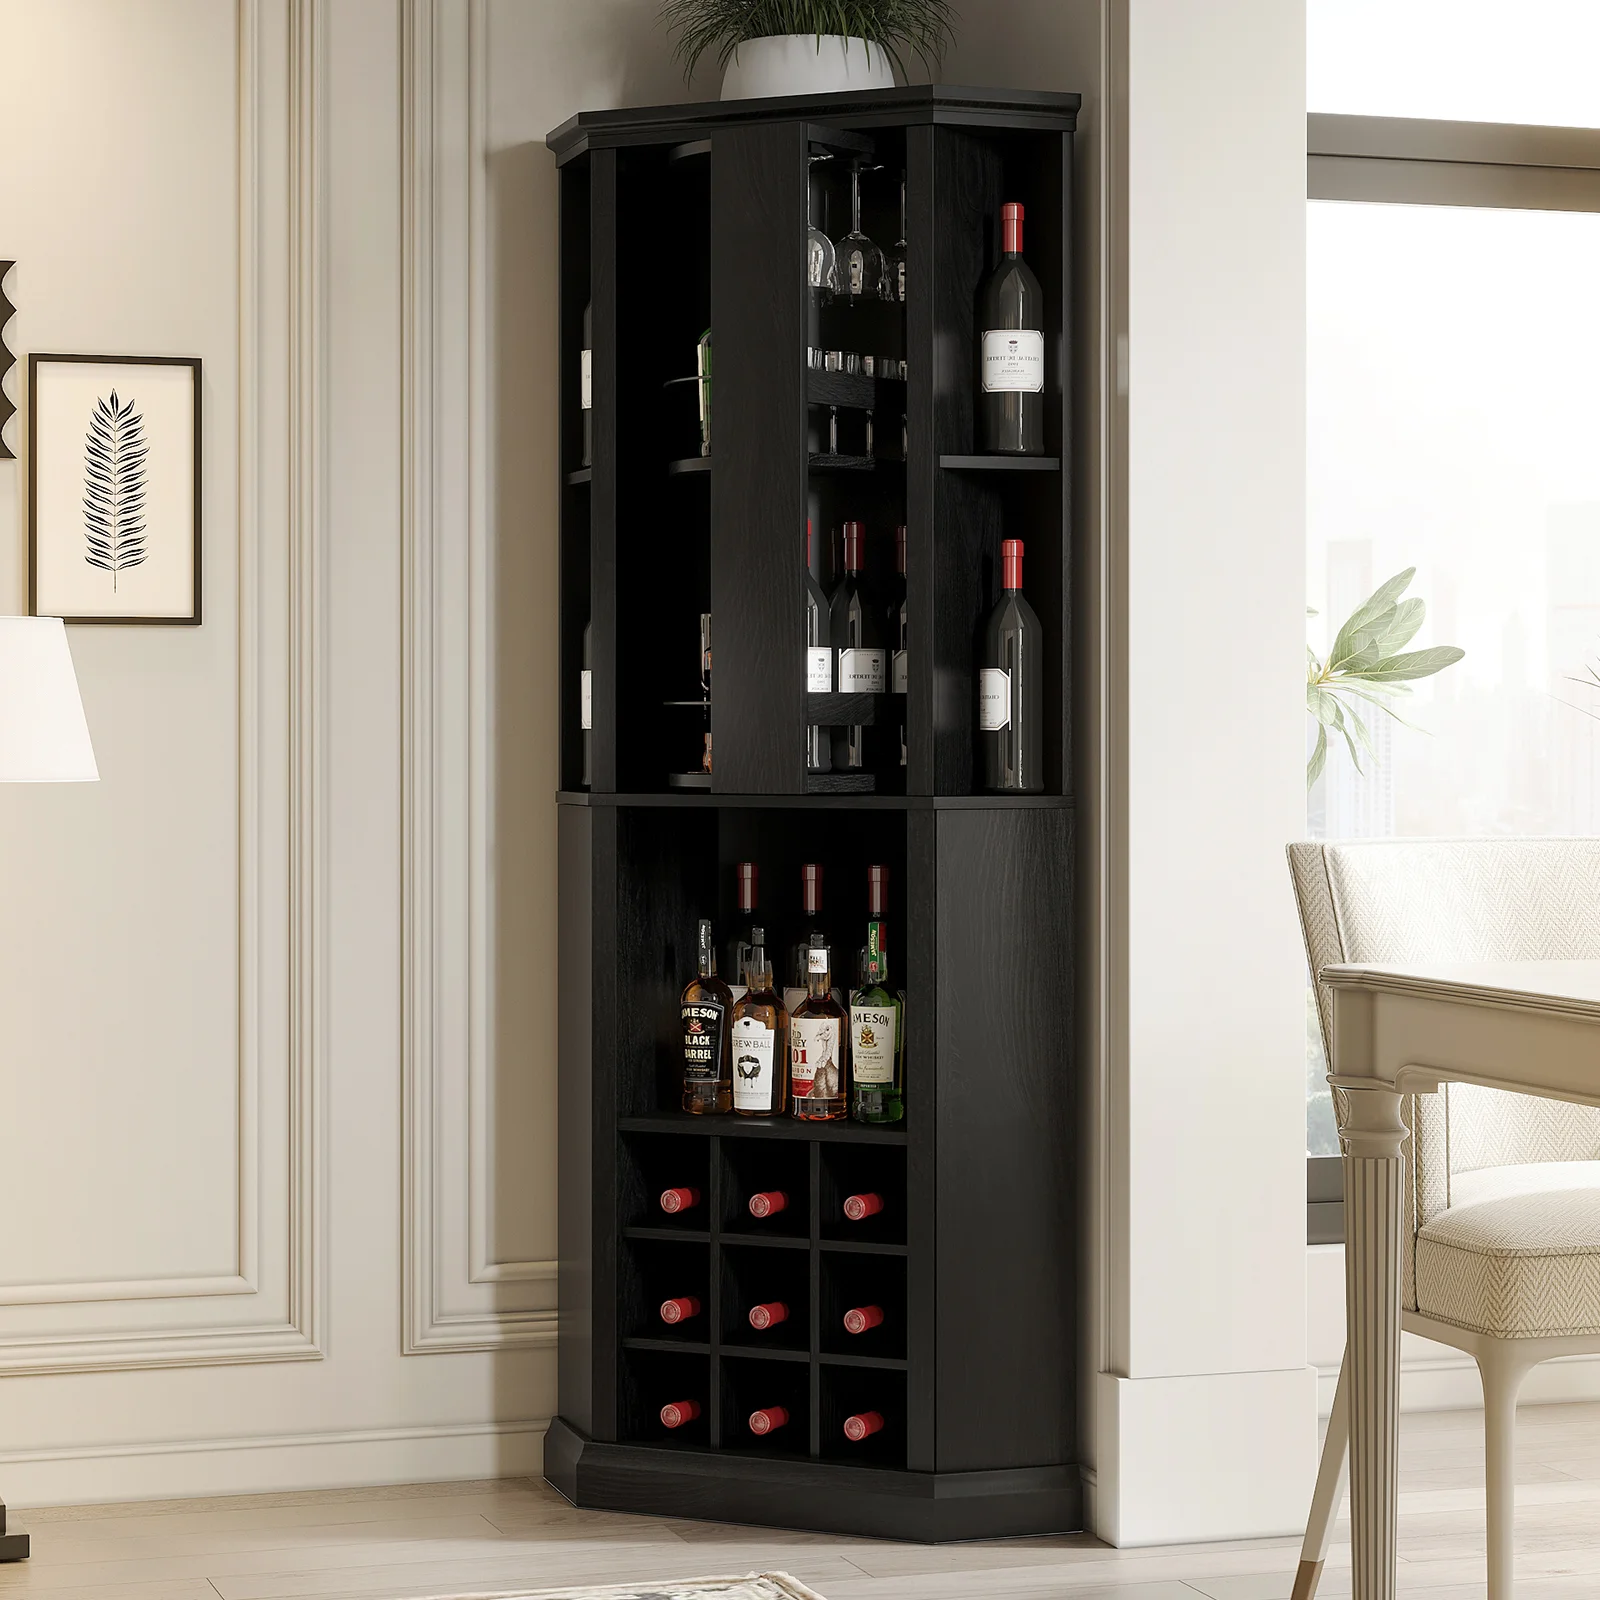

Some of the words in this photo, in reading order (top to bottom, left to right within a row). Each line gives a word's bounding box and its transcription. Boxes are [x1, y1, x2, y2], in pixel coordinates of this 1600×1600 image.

[684, 1035, 710, 1046] BLACK
[684, 1049, 712, 1060] BARREL
[792, 1048, 808, 1064] 01
